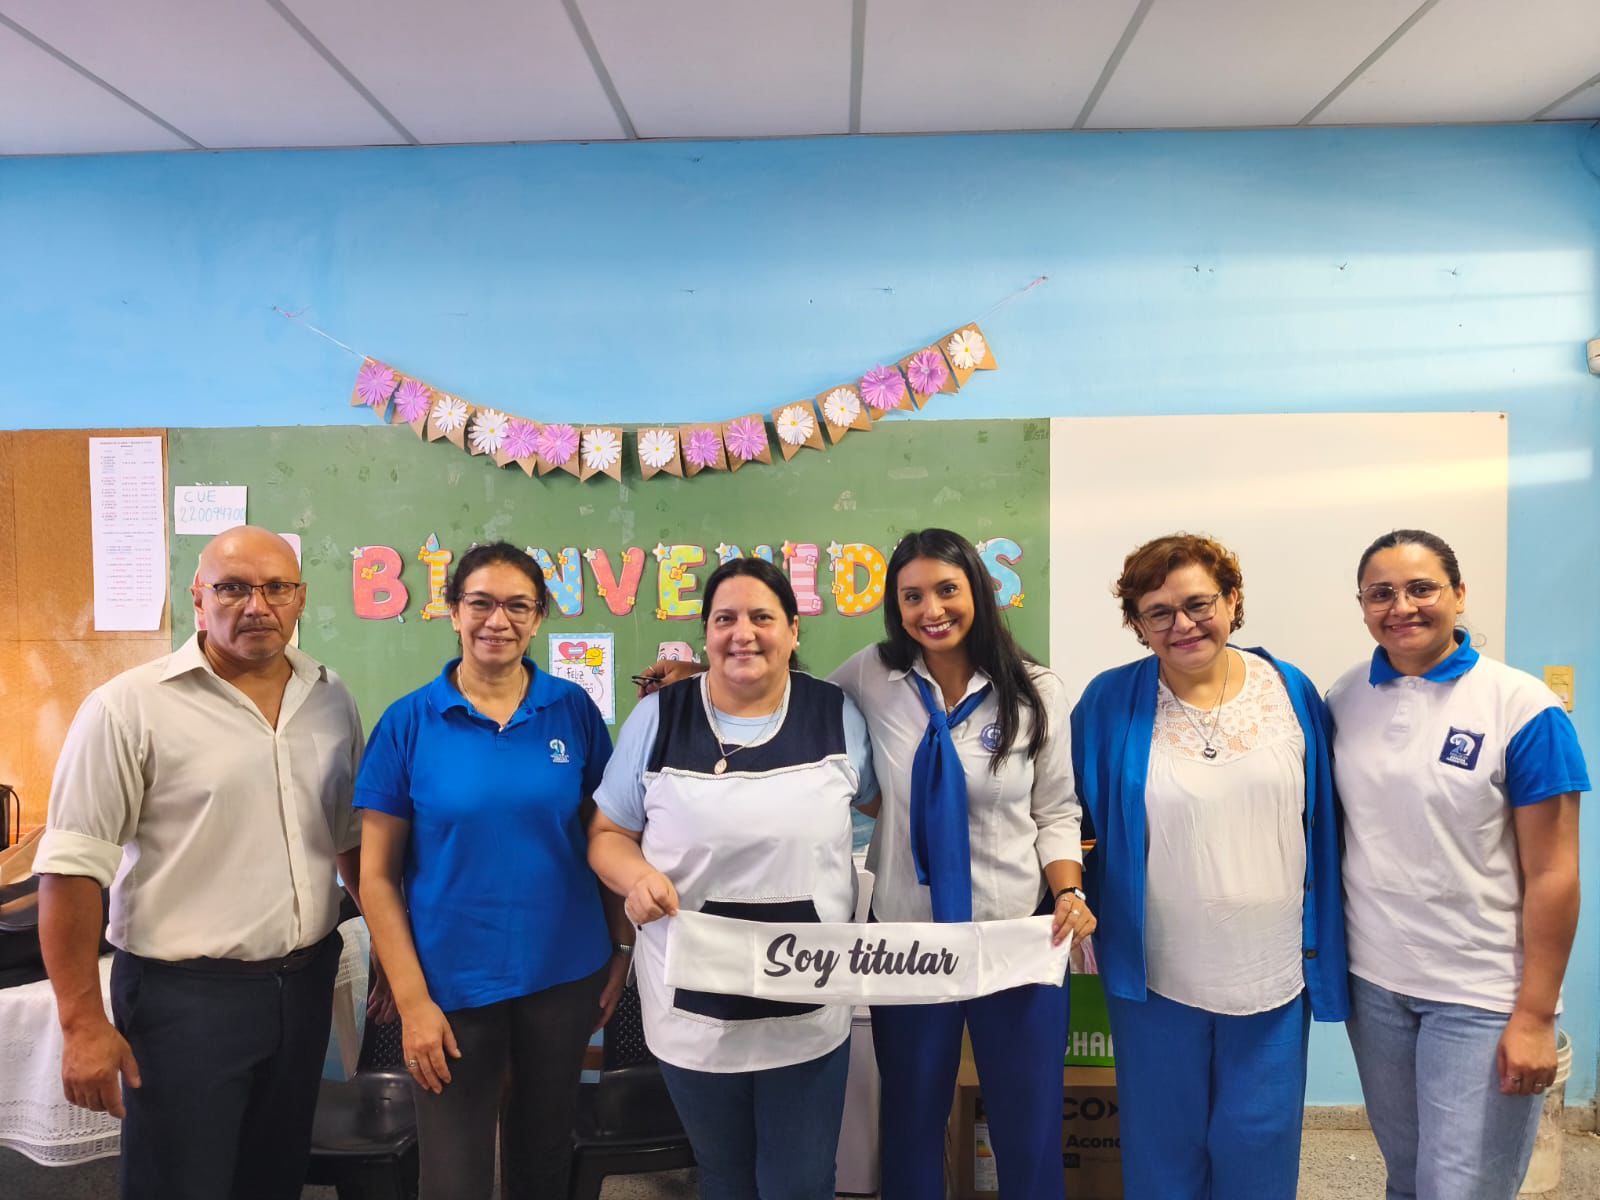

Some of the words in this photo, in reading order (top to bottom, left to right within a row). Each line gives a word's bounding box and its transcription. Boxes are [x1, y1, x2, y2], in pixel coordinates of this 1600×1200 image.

[183, 489, 217, 503] CUE
[353, 533, 1024, 621] BINVEIDS
[763, 933, 840, 988] Soy
[848, 938, 960, 976] titular
